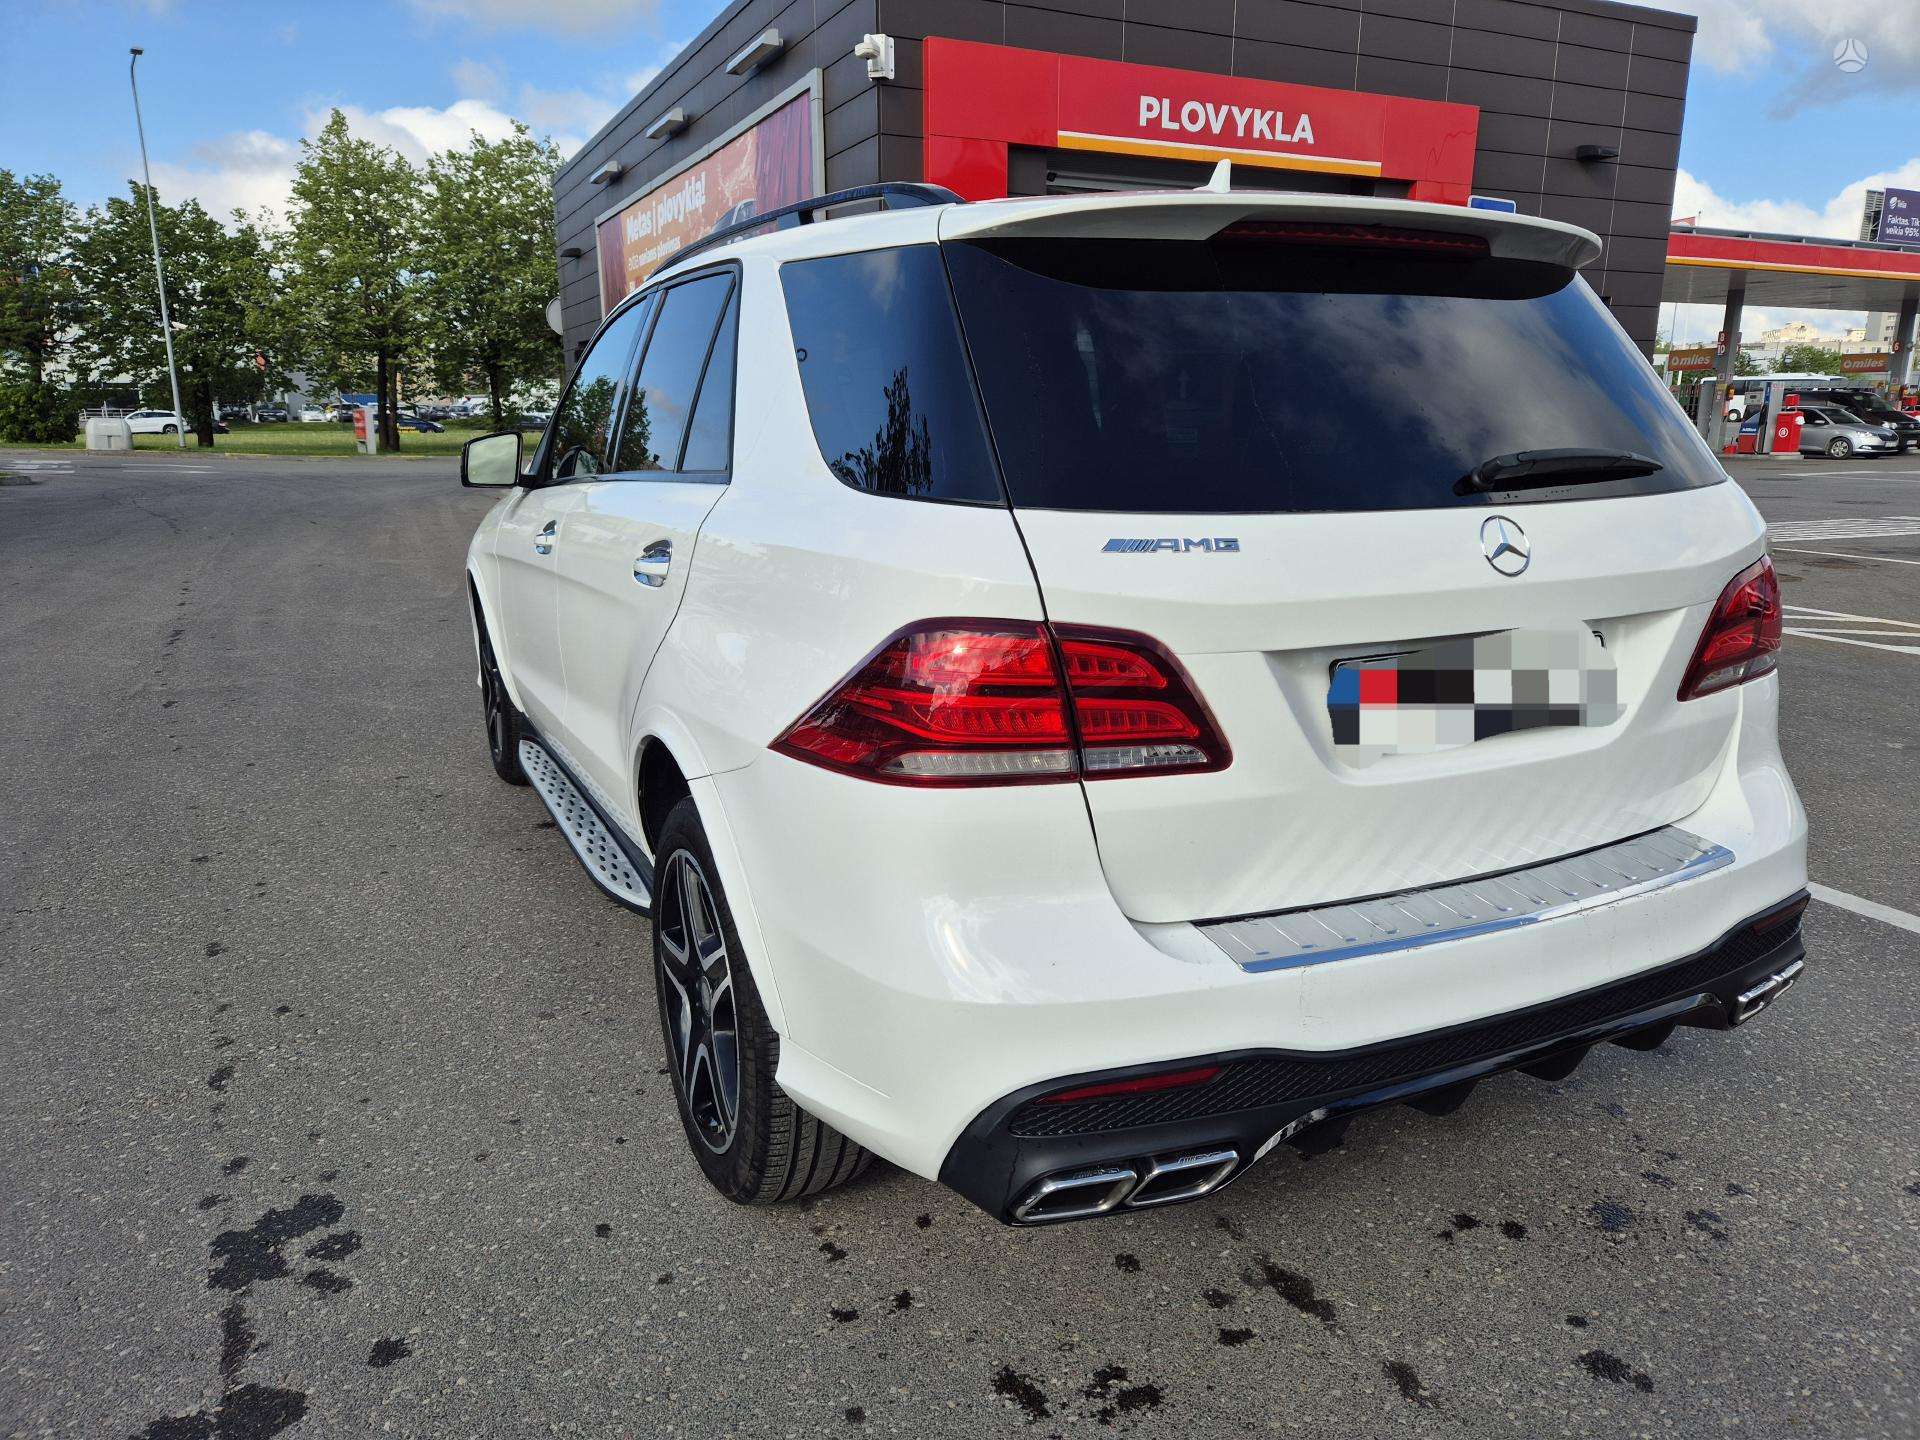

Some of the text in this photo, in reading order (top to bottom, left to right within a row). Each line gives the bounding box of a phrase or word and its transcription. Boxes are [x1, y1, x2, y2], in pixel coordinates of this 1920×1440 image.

[1139, 95, 1314, 144] PLOVYKLA
[1888, 214, 1909, 226] Faktas.
[1886, 226, 1920, 237] veikia 95%
[1720, 332, 1725, 342] 8
[1717, 343, 1725, 354] 10
[1679, 353, 1711, 366] miles
[1852, 357, 1884, 369] miles
[1148, 537, 1240, 553] AMG
